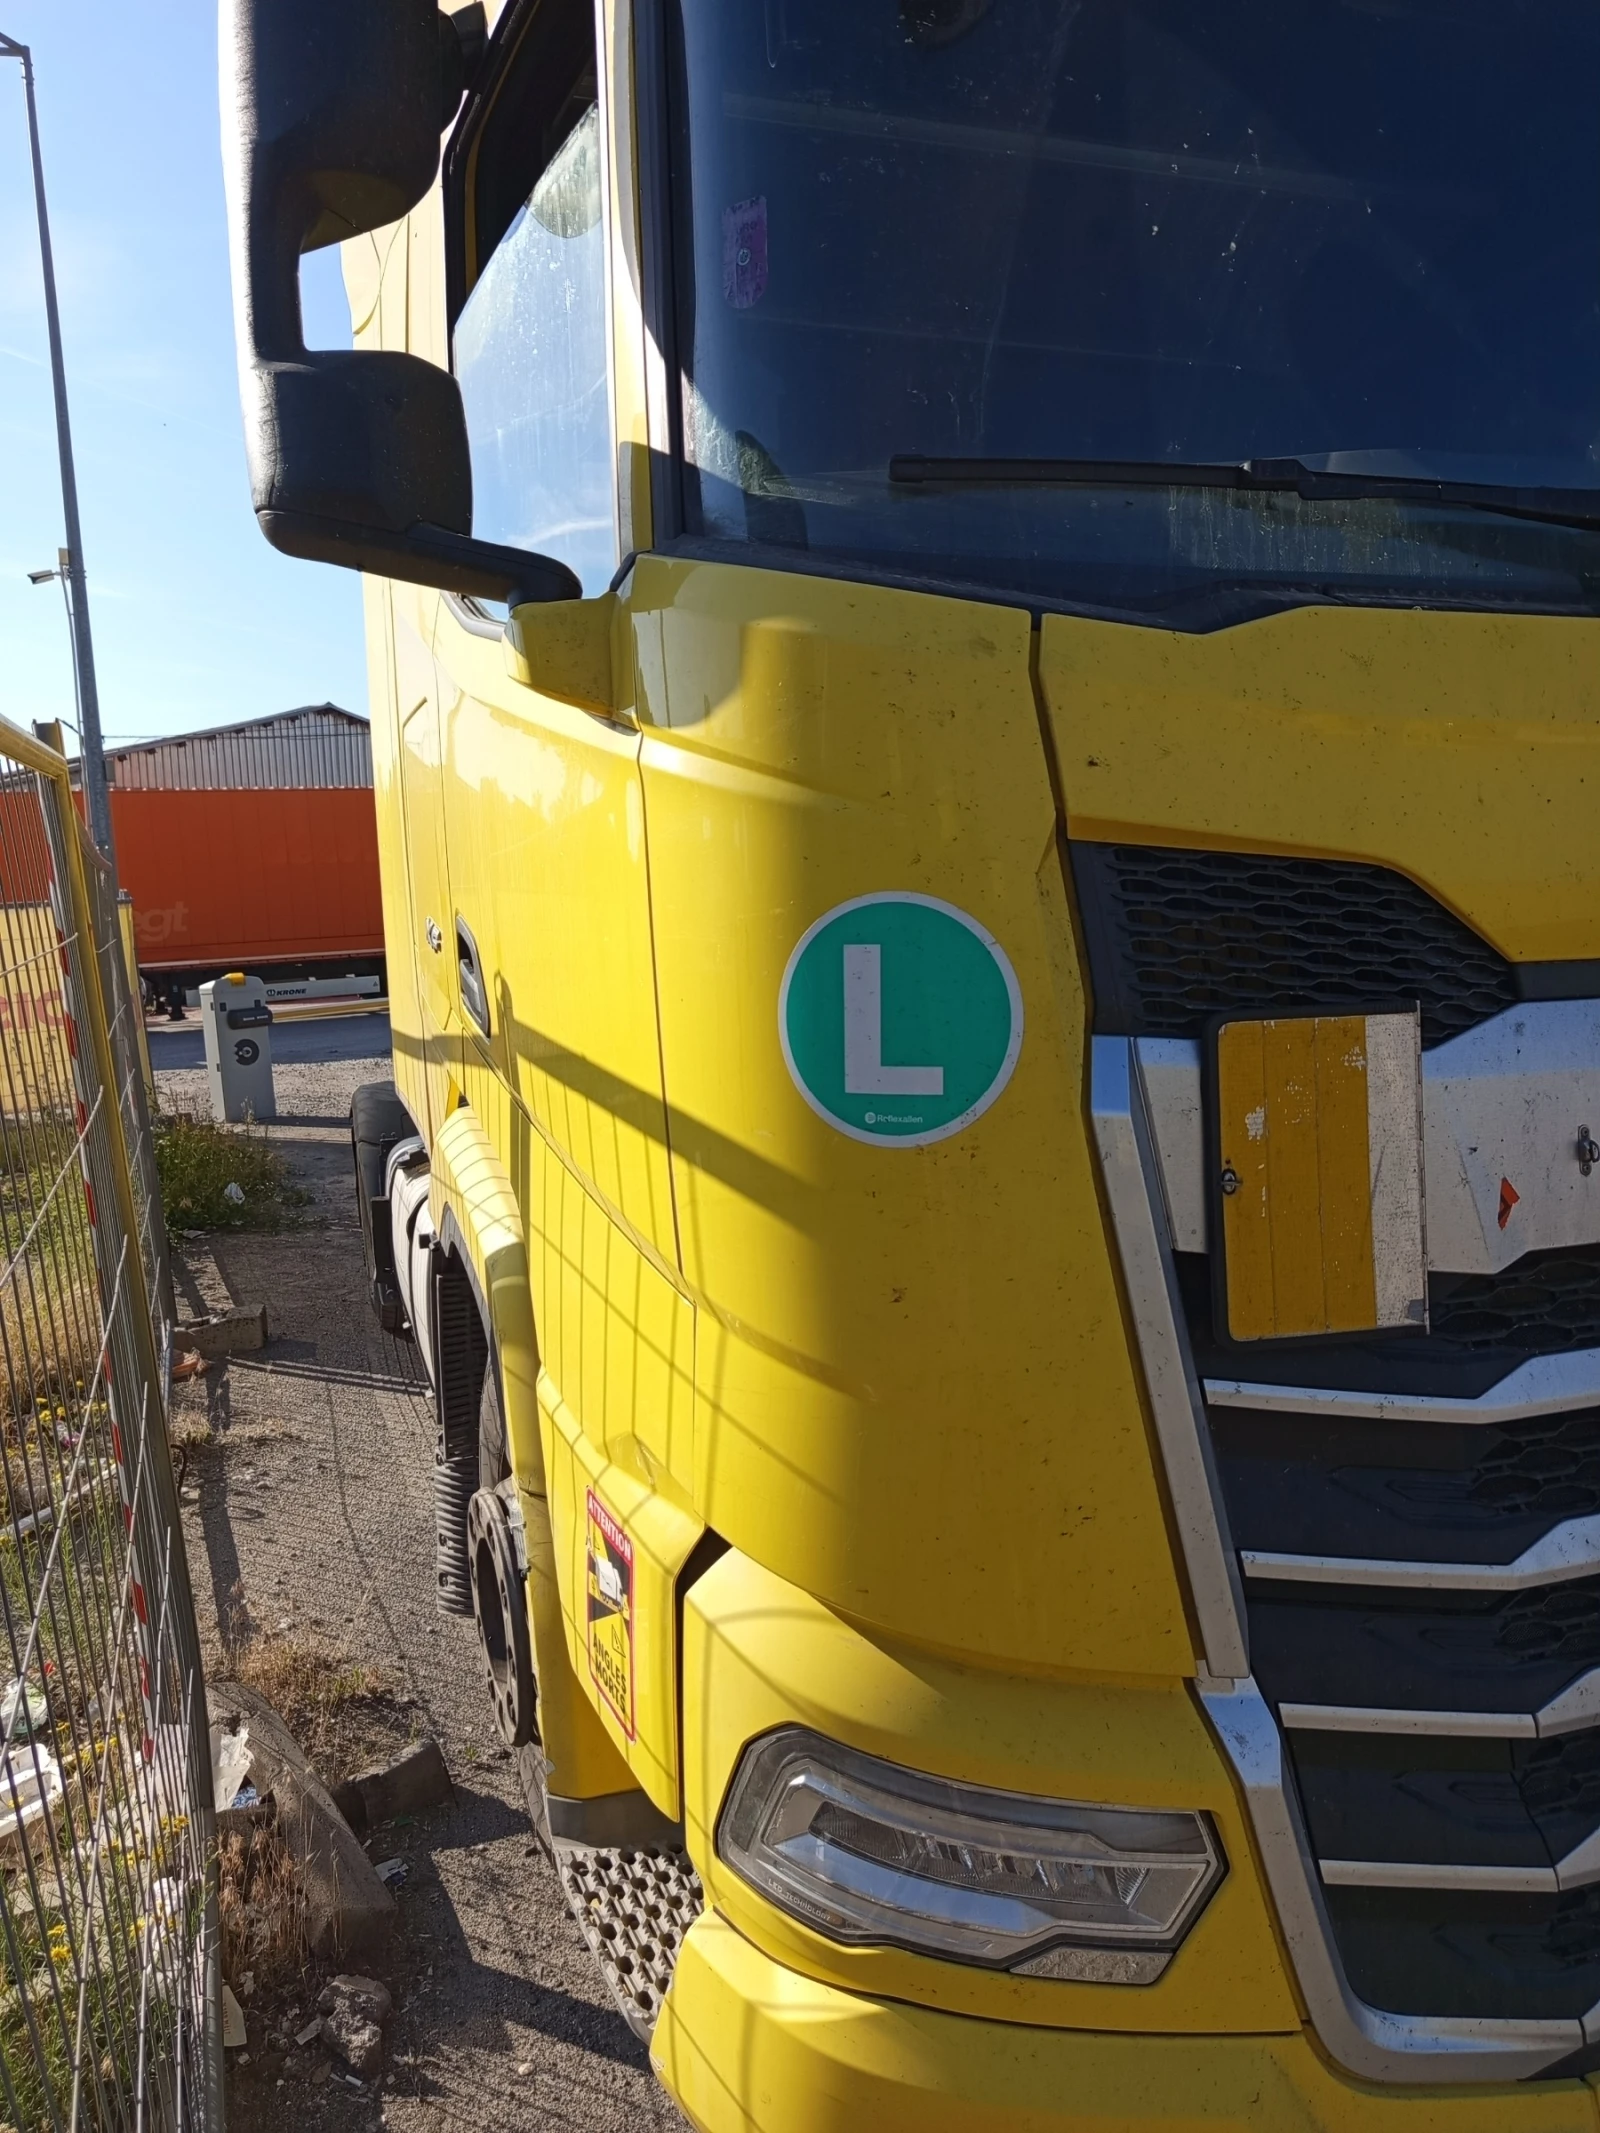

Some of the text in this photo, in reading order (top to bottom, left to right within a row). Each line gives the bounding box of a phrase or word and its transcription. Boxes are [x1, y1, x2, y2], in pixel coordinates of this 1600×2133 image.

[276, 988, 307, 996] KRONE
[843, 944, 944, 1095] L
[877, 1114, 923, 1123] Reflexallen
[588, 1494, 631, 1561] ATTENTION
[593, 1632, 627, 1695] ANGLES
[595, 1653, 626, 1715] MORTS
[768, 1878, 783, 1893] LED
